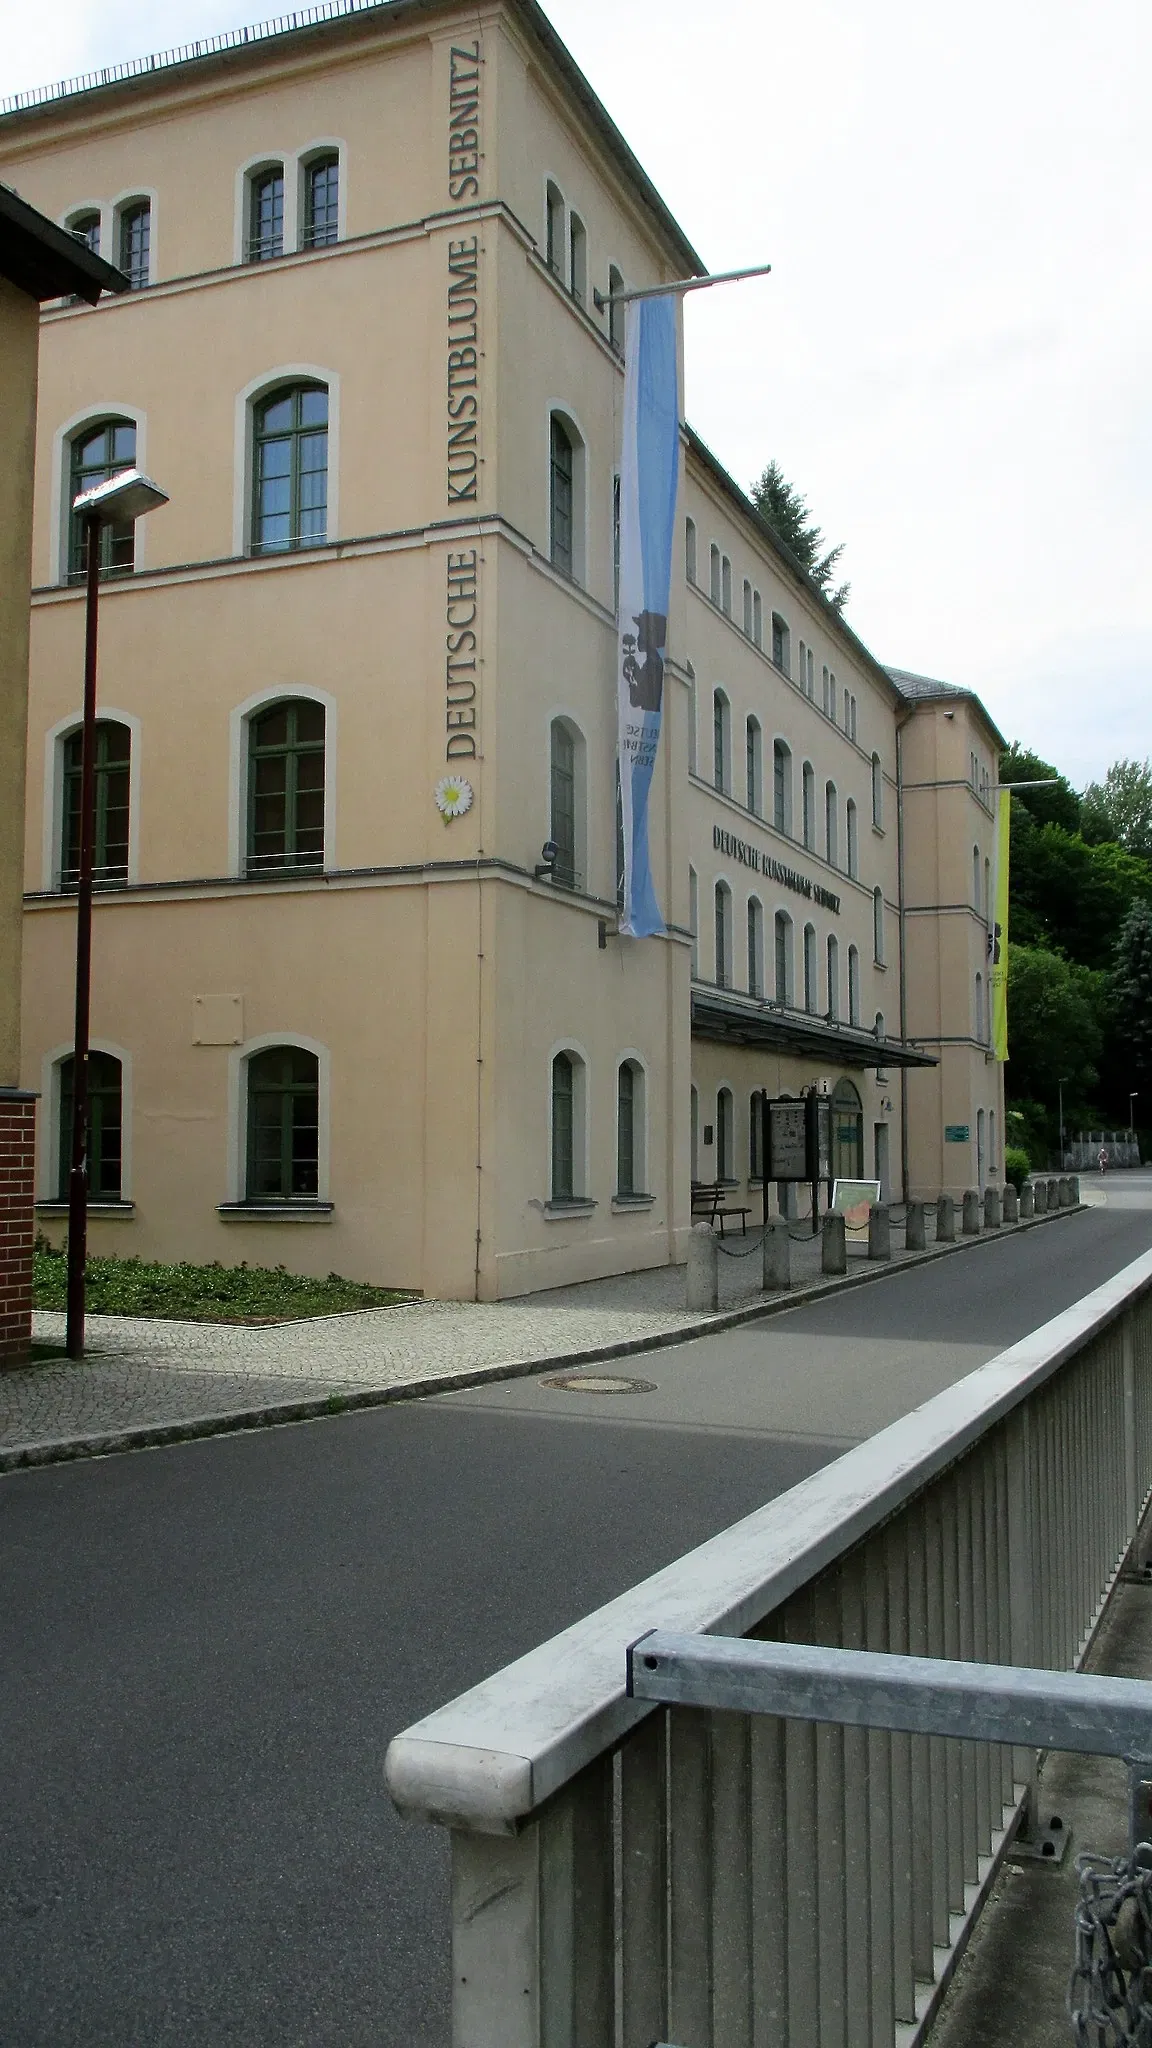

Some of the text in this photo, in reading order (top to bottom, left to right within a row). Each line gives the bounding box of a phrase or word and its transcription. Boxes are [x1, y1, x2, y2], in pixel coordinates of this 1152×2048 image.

[446, 40, 480, 762] DEUTSCHE KUNSTBLUME SEBNITZ
[713, 824, 761, 872] DEUTSCHE
